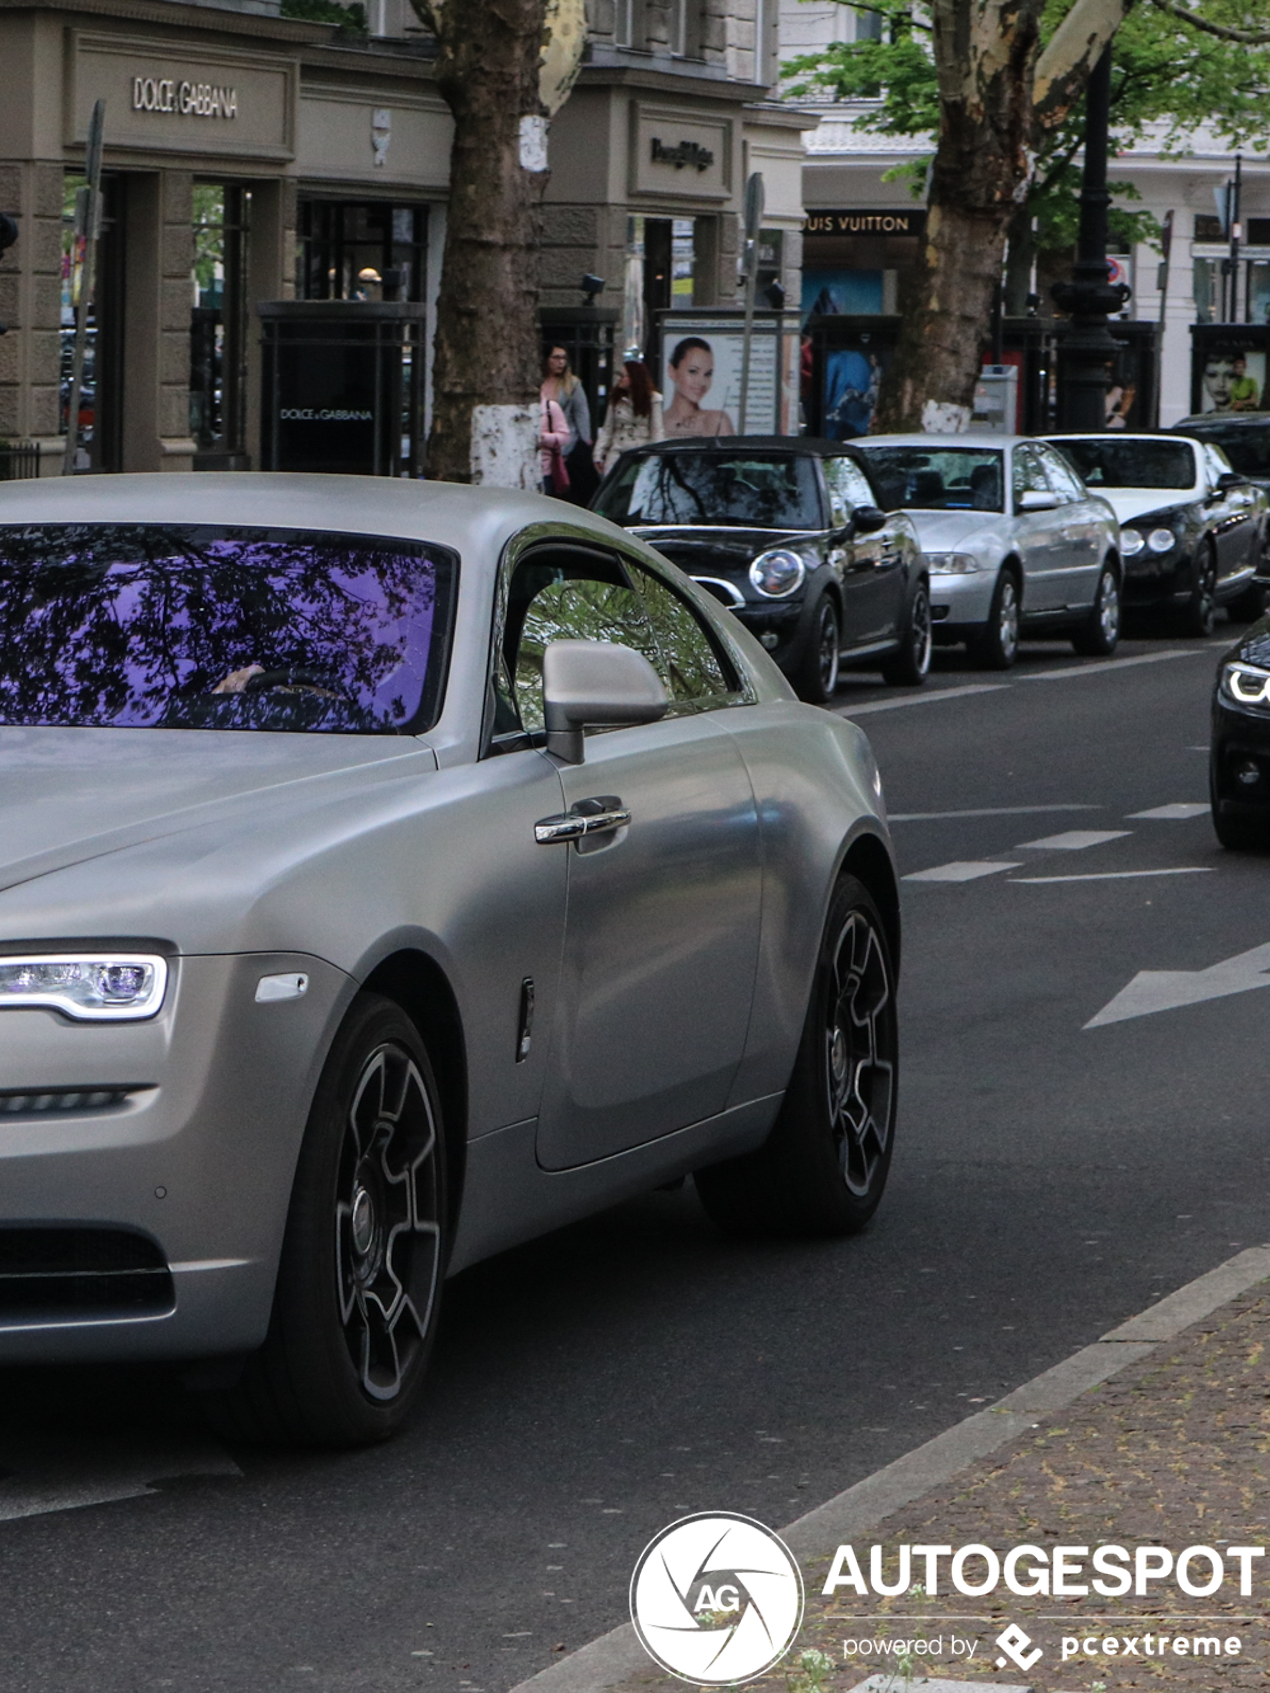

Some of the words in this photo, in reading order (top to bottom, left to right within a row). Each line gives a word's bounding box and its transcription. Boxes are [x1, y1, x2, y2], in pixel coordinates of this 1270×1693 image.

[134, 78, 174, 112] DOLCE
[179, 81, 237, 118] GABBANA
[802, 216, 833, 231] UIS
[838, 216, 910, 231] VUITTON
[280, 408, 314, 420] DOLCE
[319, 408, 373, 420] GABBANA
